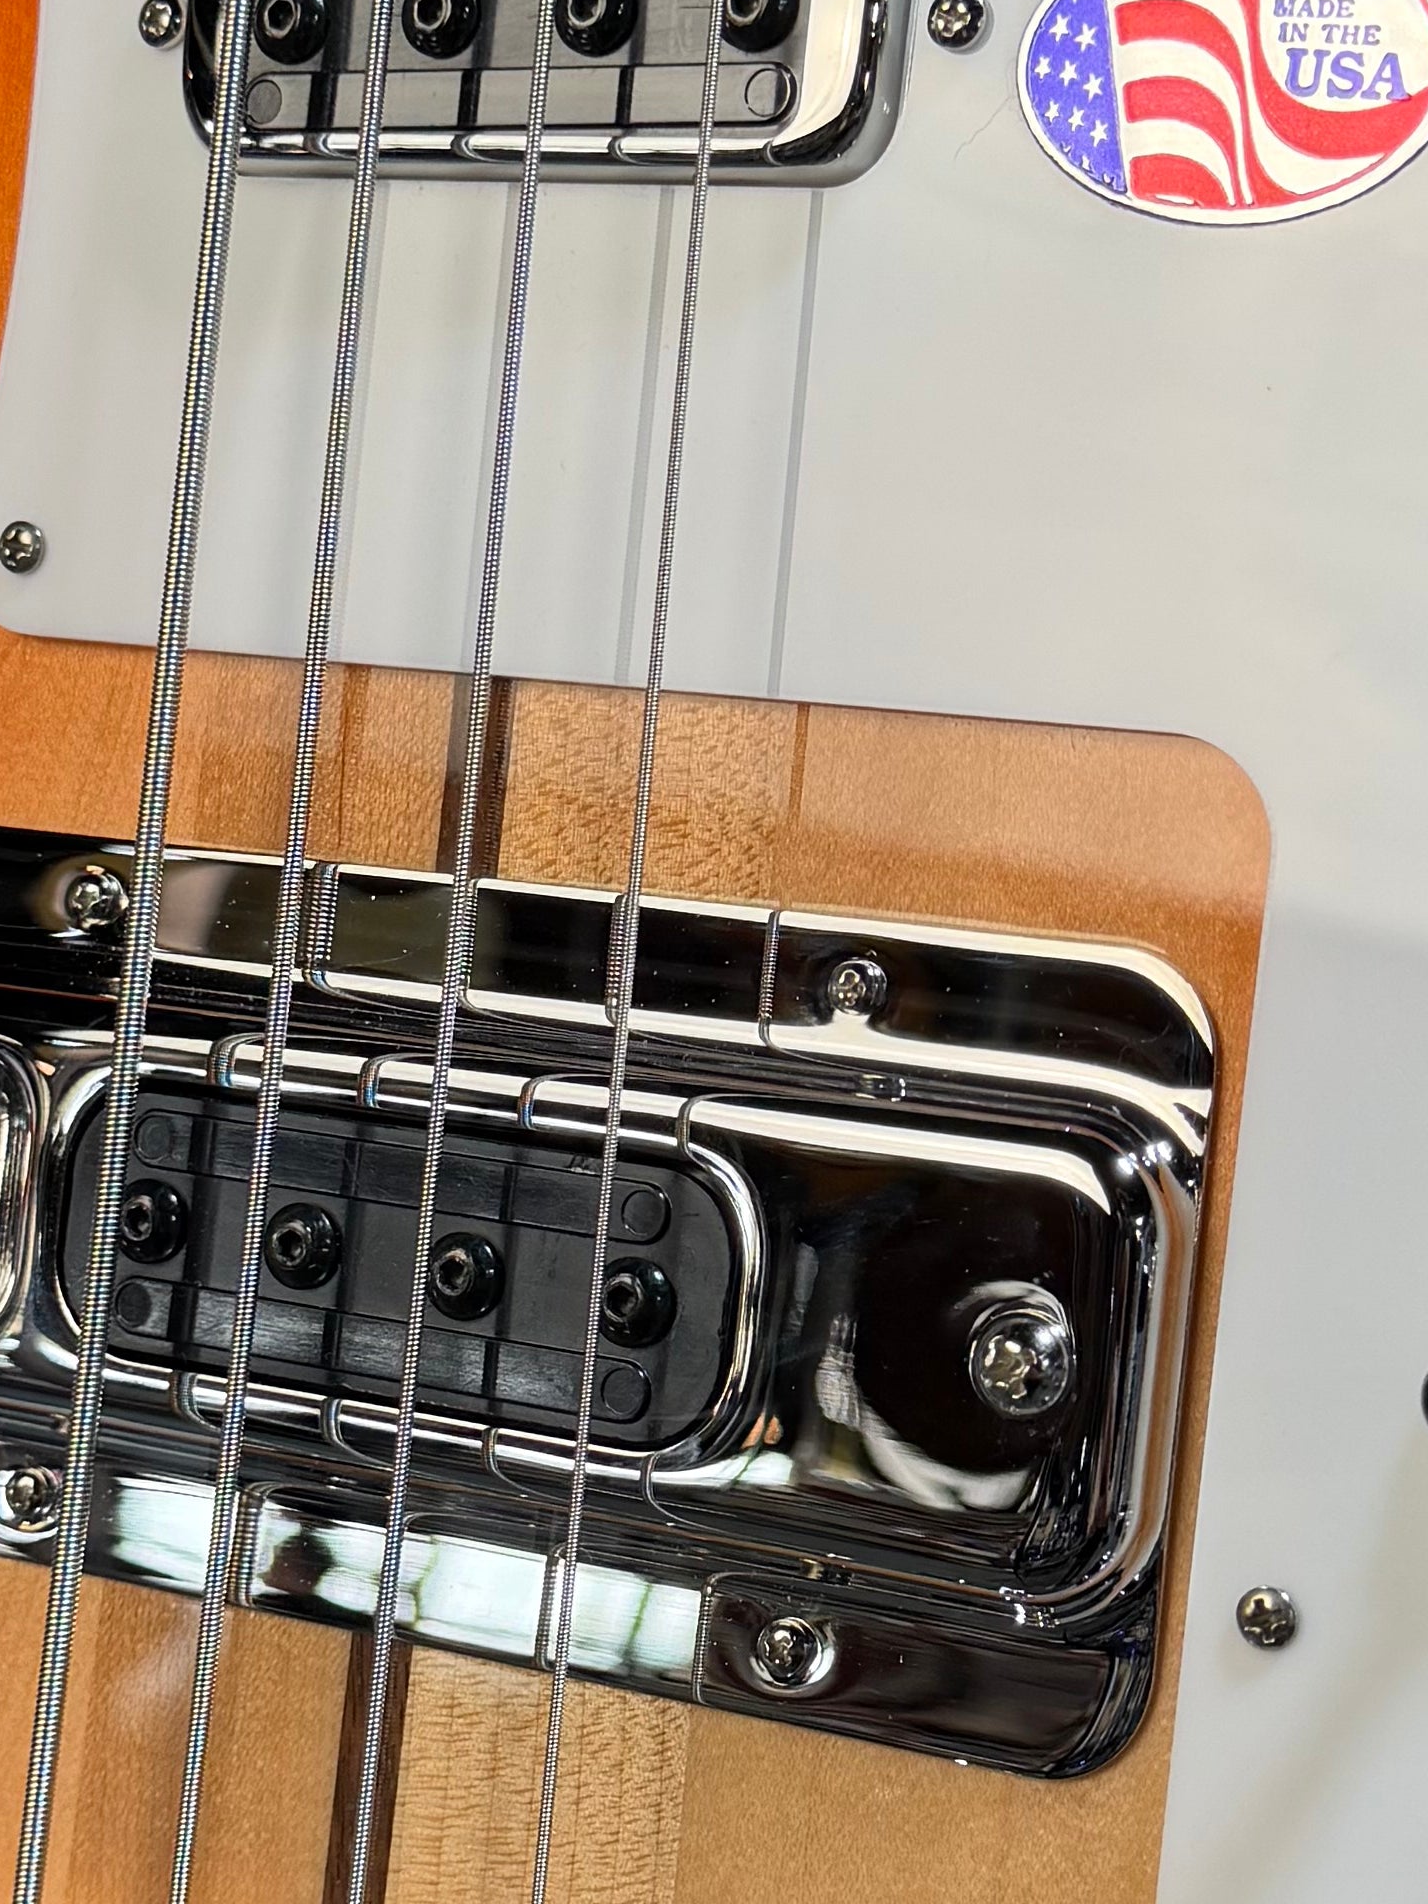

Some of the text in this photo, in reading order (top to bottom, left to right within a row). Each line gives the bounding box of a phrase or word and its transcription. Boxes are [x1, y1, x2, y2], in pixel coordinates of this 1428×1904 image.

[1278, 22, 1381, 46] IN THE
[1285, 48, 1412, 101] USA
